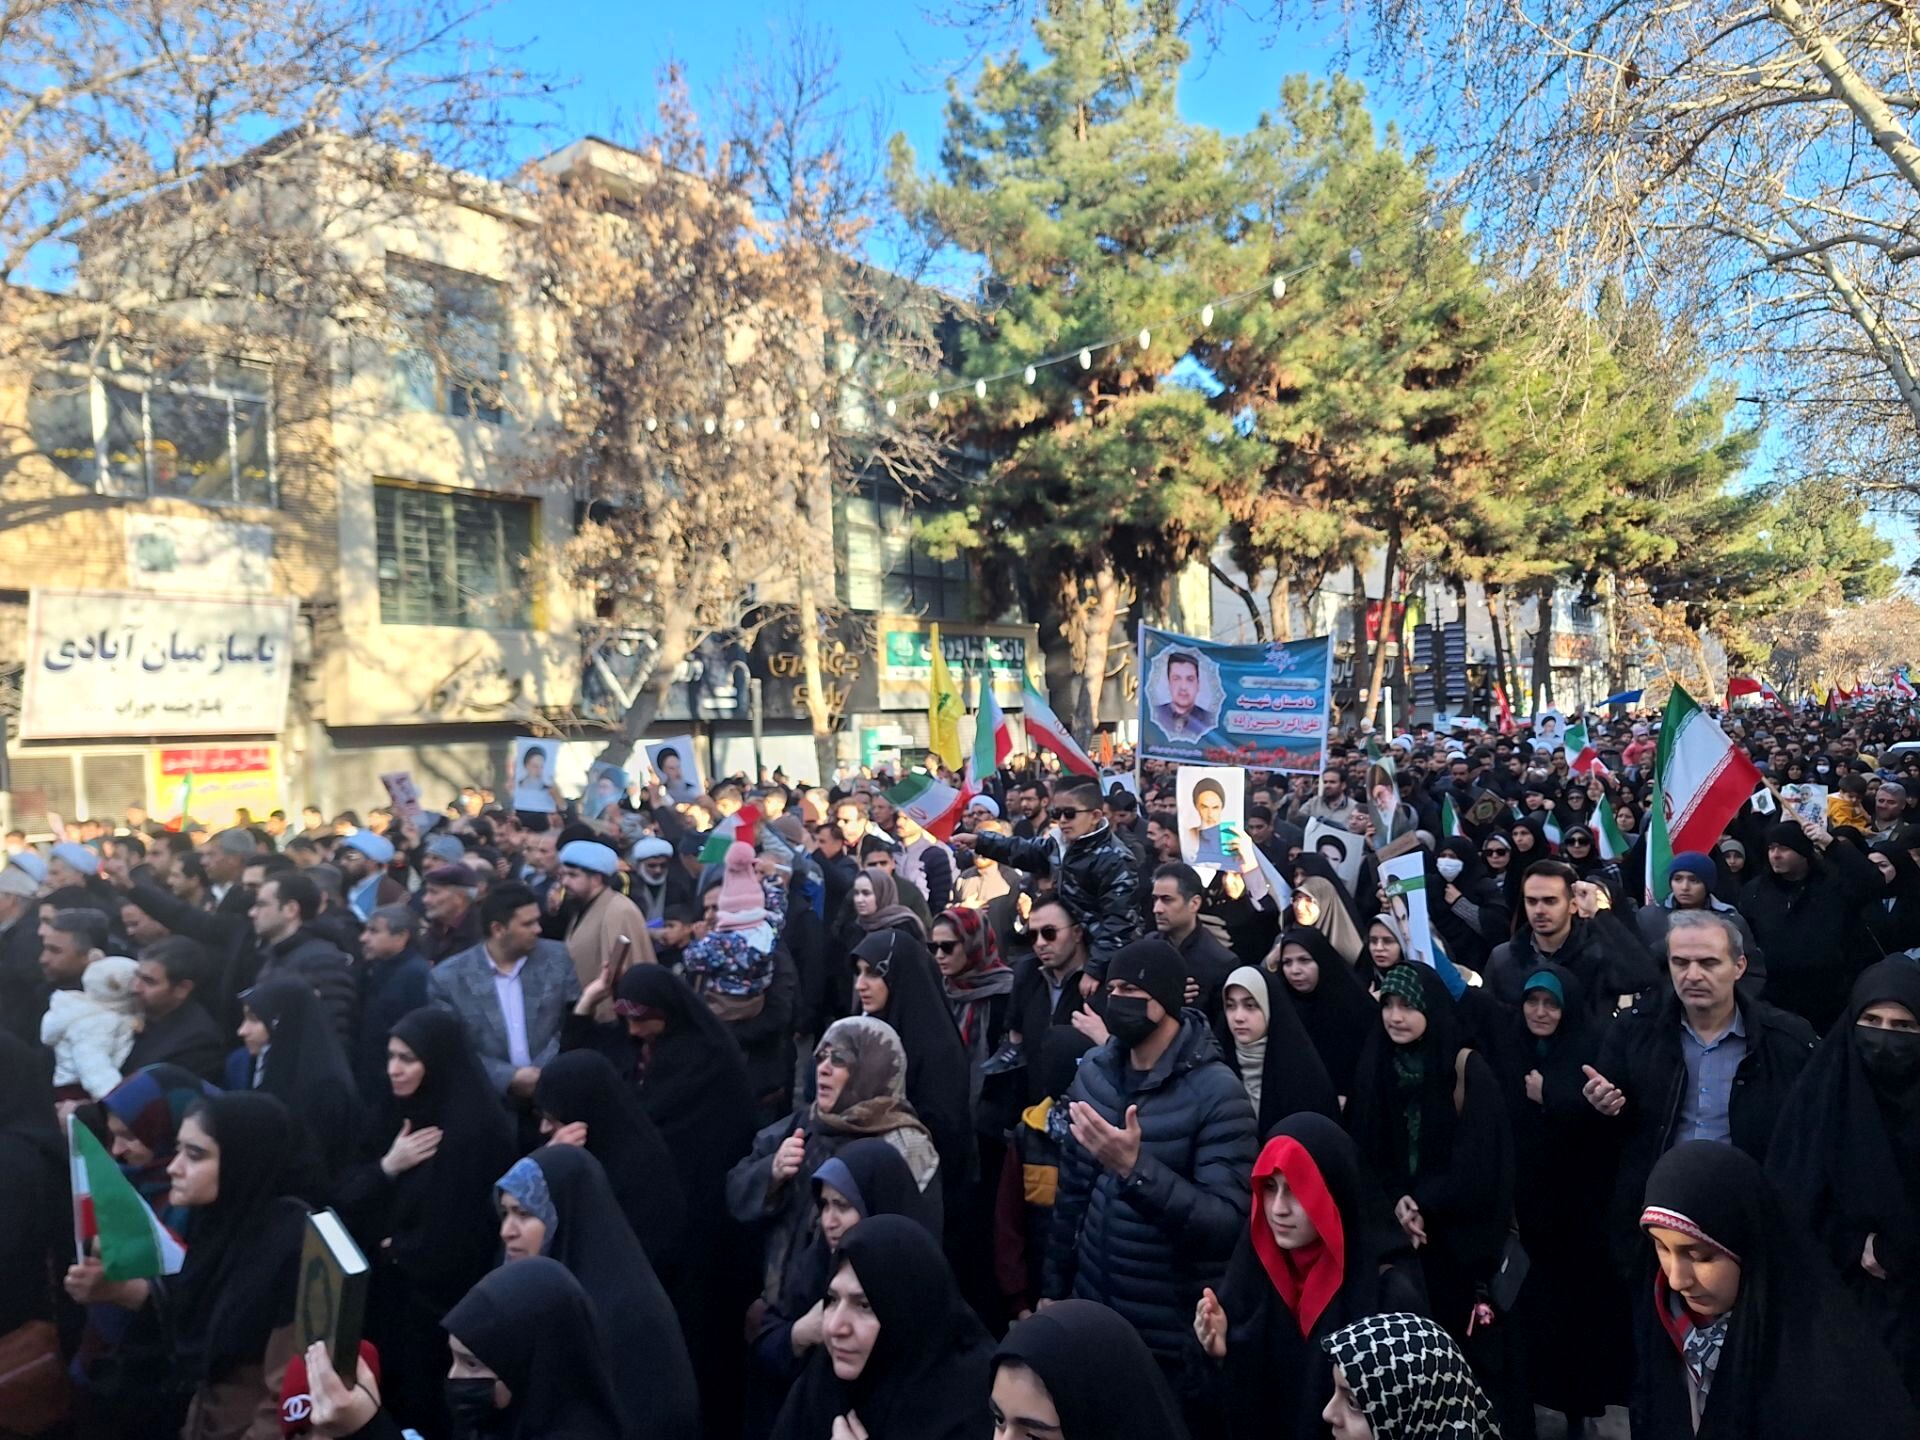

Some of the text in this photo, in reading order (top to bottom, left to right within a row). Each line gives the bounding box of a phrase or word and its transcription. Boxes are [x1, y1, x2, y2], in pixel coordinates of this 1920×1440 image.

[44, 622, 275, 675] پاساژ میان آبادی
[990, 638, 1025, 668] بانک
[768, 647, 861, 682] جواری
[1236, 693, 1316, 710] دادستان شهید
[1282, 716, 1301, 733] اکبر
[1301, 717, 1320, 734] علی
